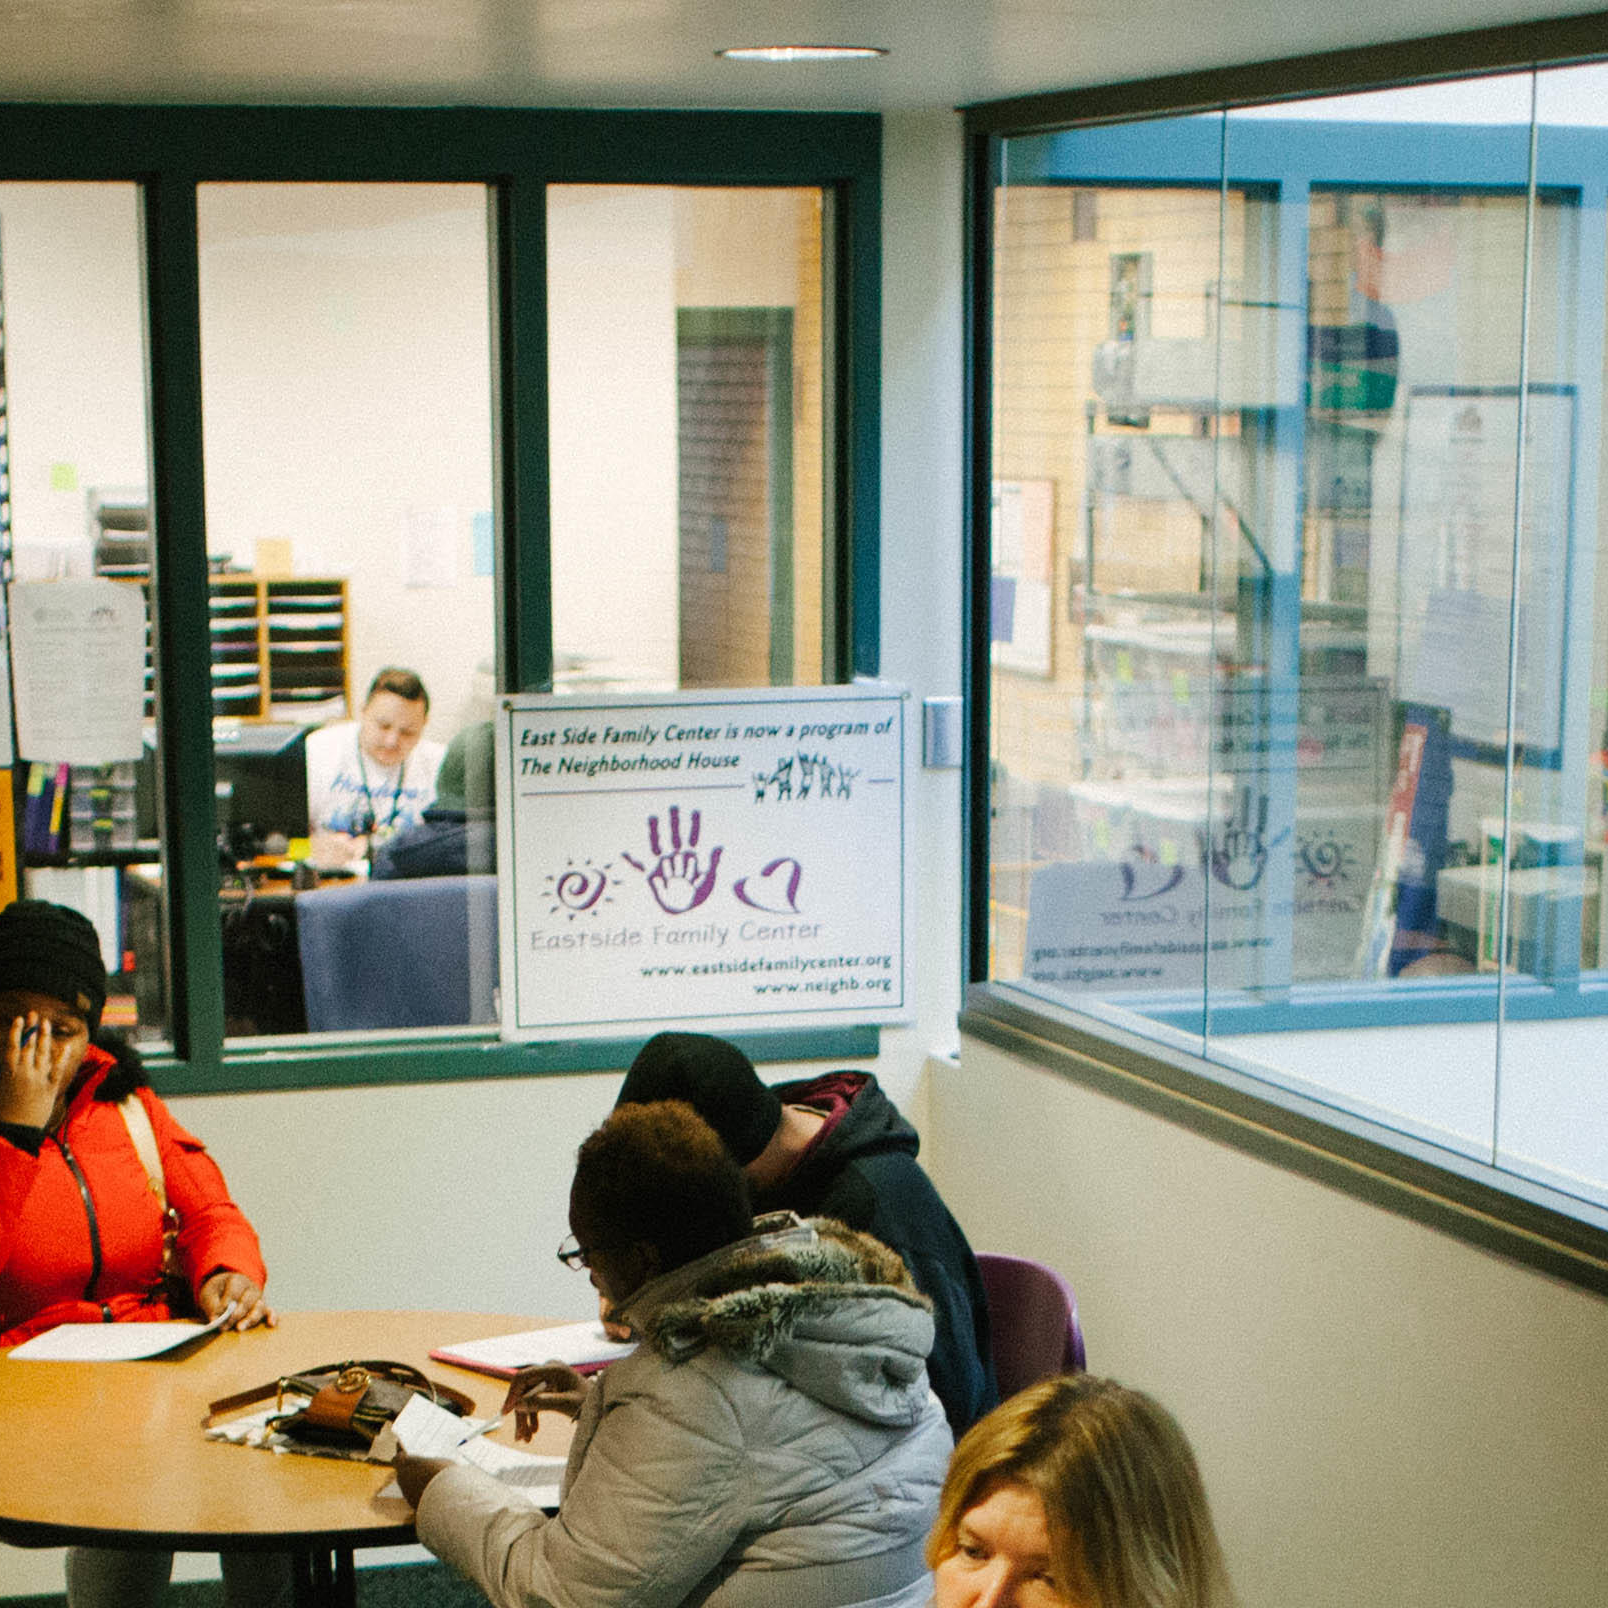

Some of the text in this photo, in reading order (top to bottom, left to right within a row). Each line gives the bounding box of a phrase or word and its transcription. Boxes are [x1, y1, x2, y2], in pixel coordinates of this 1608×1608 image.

[521, 715, 894, 746] East Side Family Center is now a program of
[521, 750, 741, 778] The Neighborhood House
[530, 919, 824, 950] Eastside Family Center
[640, 953, 893, 977] www.eastsidefamilycenter.org
[754, 975, 893, 995] www.neighb.org
